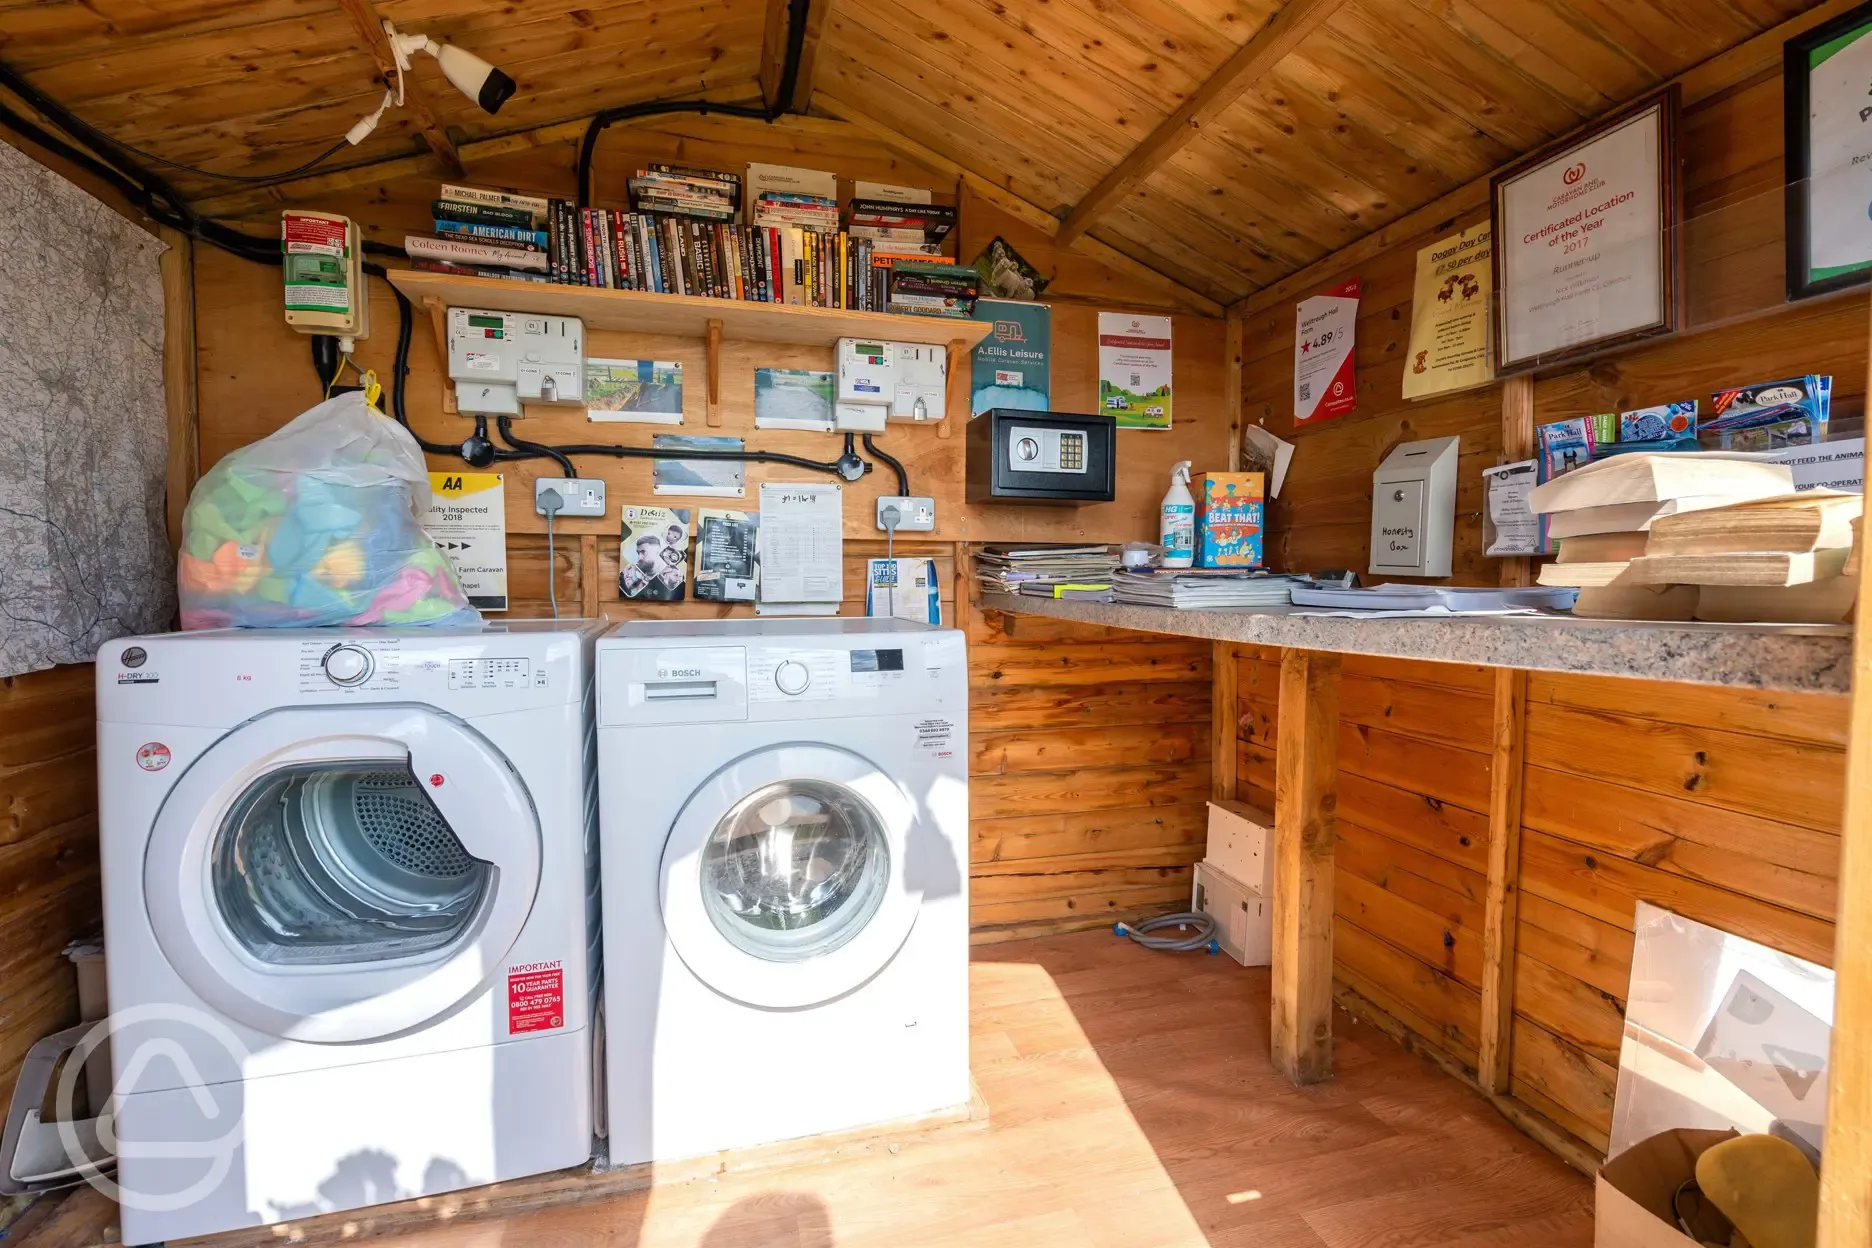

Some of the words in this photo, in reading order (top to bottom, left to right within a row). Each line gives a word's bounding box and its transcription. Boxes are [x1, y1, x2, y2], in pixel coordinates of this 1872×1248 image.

[454, 190, 477, 200] MICHAEL
[480, 193, 500, 202] PALMER
[1546, 190, 1588, 212] MOTORHOME
[1590, 180, 1606, 193] CLUB
[1553, 184, 1583, 202] CARAVAN
[1584, 178, 1598, 188] AND
[440, 202, 478, 214] FAIRSTEIN
[1524, 211, 1582, 244] Certificated
[1584, 190, 1634, 218] Location
[472, 226, 515, 240] AMERICAN
[518, 231, 536, 242] DIRT
[1548, 233, 1560, 248] of
[1561, 227, 1578, 242] the
[1580, 218, 1604, 237] Year
[412, 240, 448, 252] Coleen
[450, 244, 489, 256] Rooney
[1431, 246, 1458, 262] Doggy
[1459, 239, 1476, 251] Day
[1477, 231, 1490, 242] Car
[1564, 237, 1589, 254] 2017
[694, 241, 704, 270] BASIC
[1458, 254, 1473, 268] per
[1475, 248, 1490, 261] day
[702, 240, 712, 288] CLOVERFIELD
[1553, 252, 1601, 275] Runner-up
[1328, 306, 1339, 316] Hall
[1301, 327, 1313, 336] Farm
[978, 346, 1007, 356] A.Ellis
[1010, 349, 1044, 359] Leisure
[1760, 395, 1779, 403] Park
[1567, 428, 1582, 437] Hall
[1835, 452, 1864, 460] ANIMA
[442, 477, 463, 490] AA
[1817, 479, 1862, 488] CO-OPERAT
[448, 506, 488, 514] Inspected
[1209, 512, 1233, 523] BEAT
[1234, 512, 1260, 523] THAT!
[1382, 527, 1414, 538] Honesty
[1390, 541, 1409, 551] Box
[508, 960, 562, 974] IMPORTANT
[512, 983, 525, 993] 10
[526, 984, 558, 992] GUARANTEE
